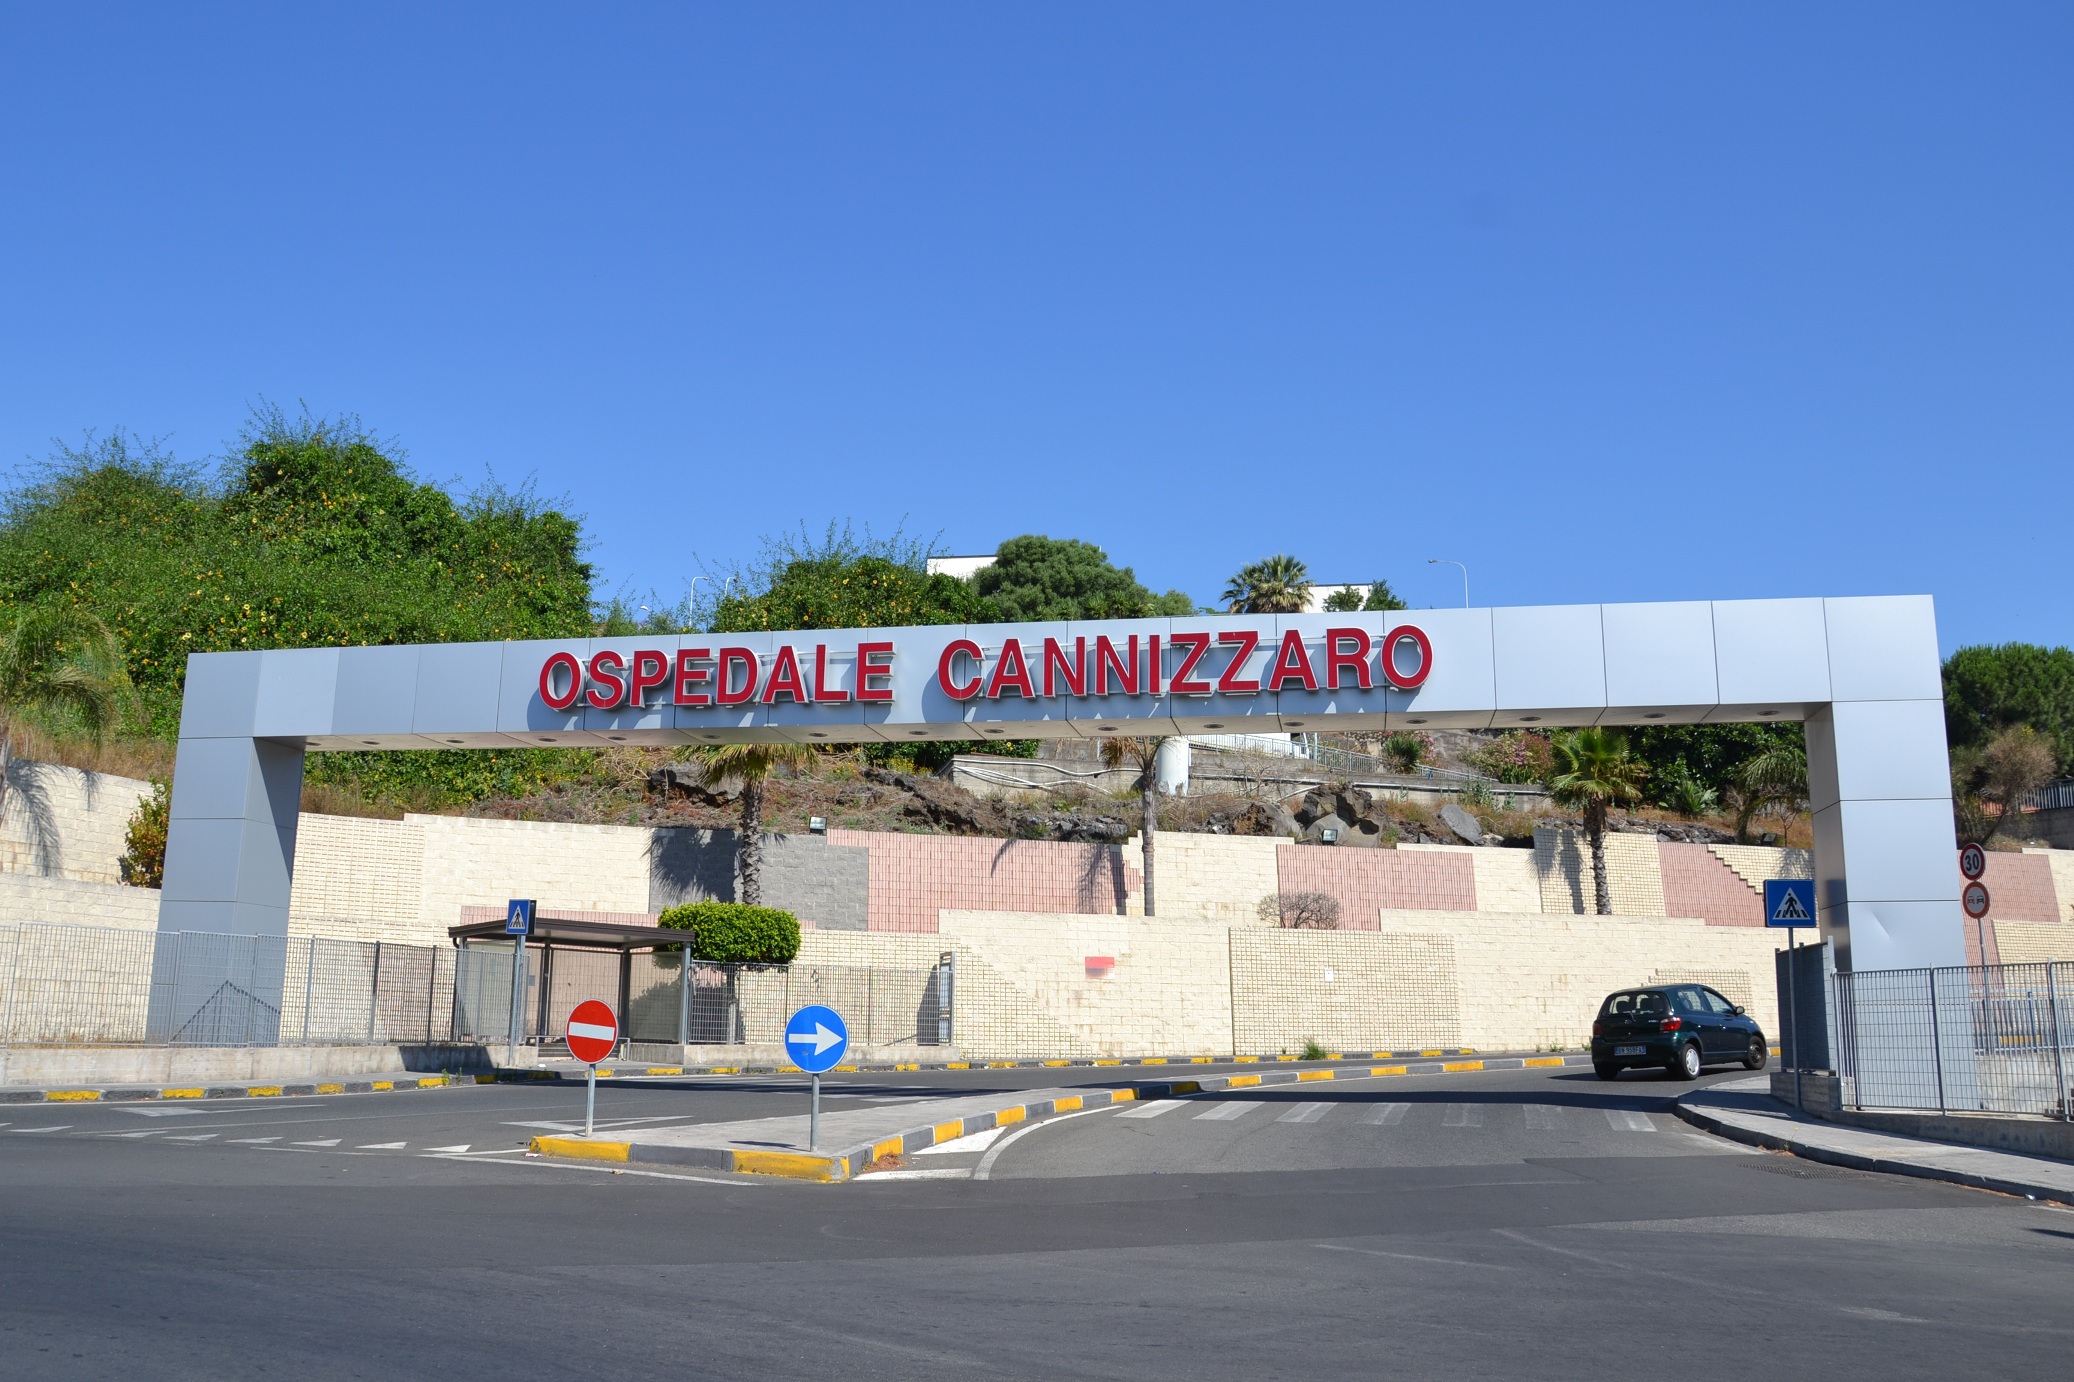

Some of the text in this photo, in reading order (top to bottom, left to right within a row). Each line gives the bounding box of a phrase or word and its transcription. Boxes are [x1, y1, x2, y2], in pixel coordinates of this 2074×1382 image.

[539, 624, 1434, 710] OSPEDALE CANNIZZARO
[1964, 853, 1980, 872] 30
